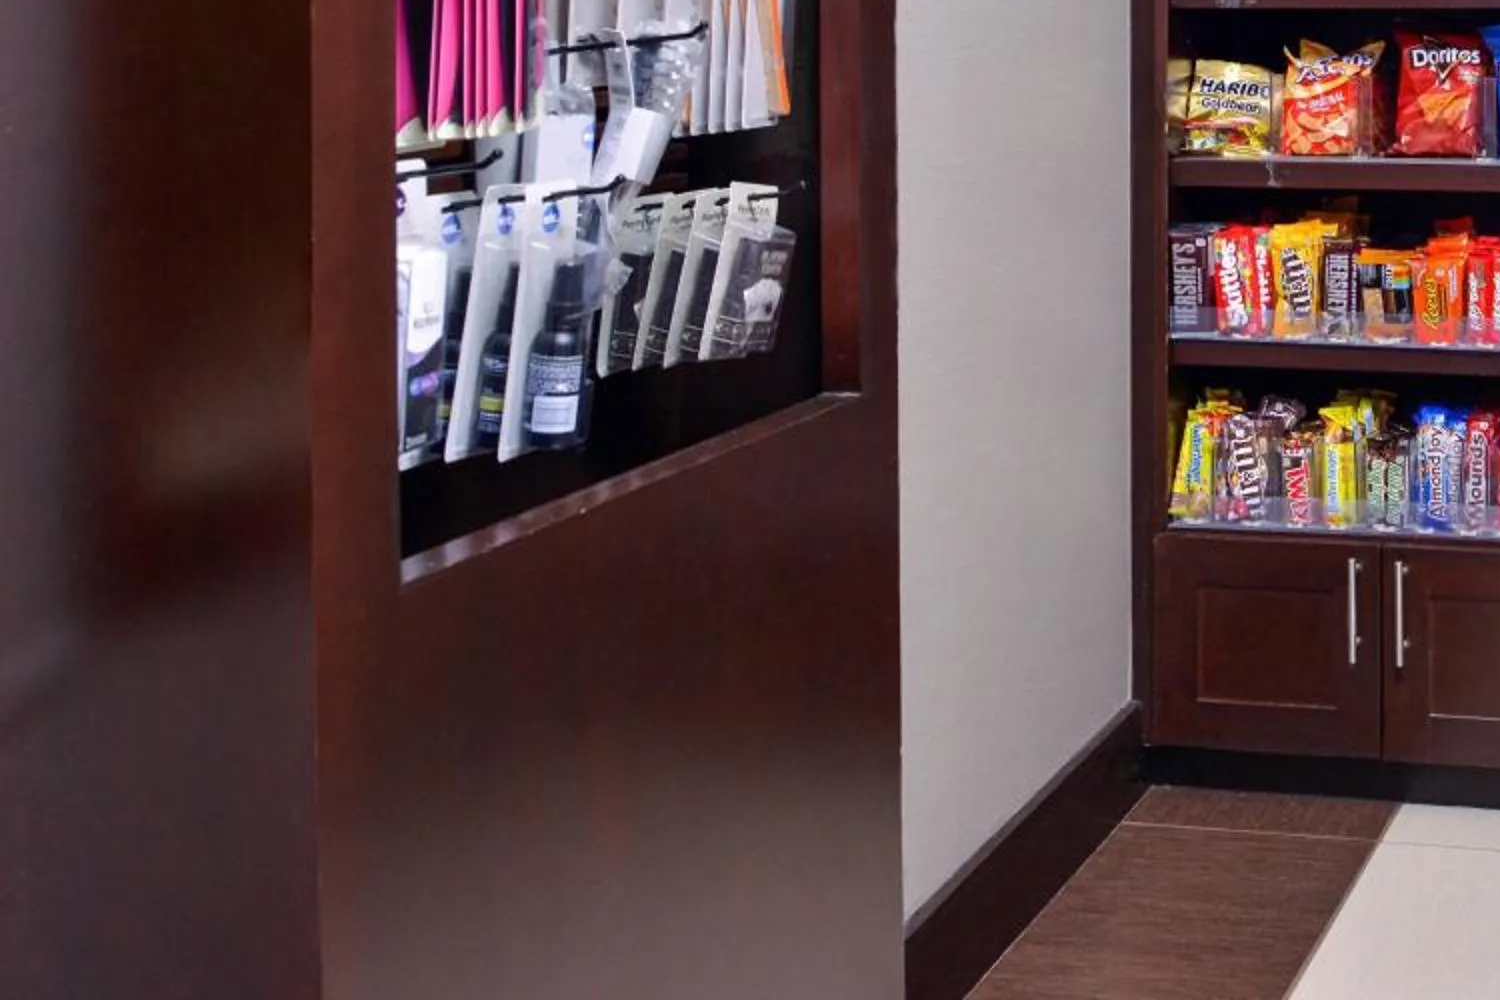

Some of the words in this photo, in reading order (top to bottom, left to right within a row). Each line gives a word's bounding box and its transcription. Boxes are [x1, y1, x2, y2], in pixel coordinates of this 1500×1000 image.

[1412, 47, 1481, 67] Doritos
[1173, 243, 1198, 326] HERSHEY'S
[1218, 238, 1249, 326] Skittles
[1428, 426, 1444, 454] Joy
[1428, 455, 1445, 520] Almond
[1467, 431, 1486, 524] Mounds
